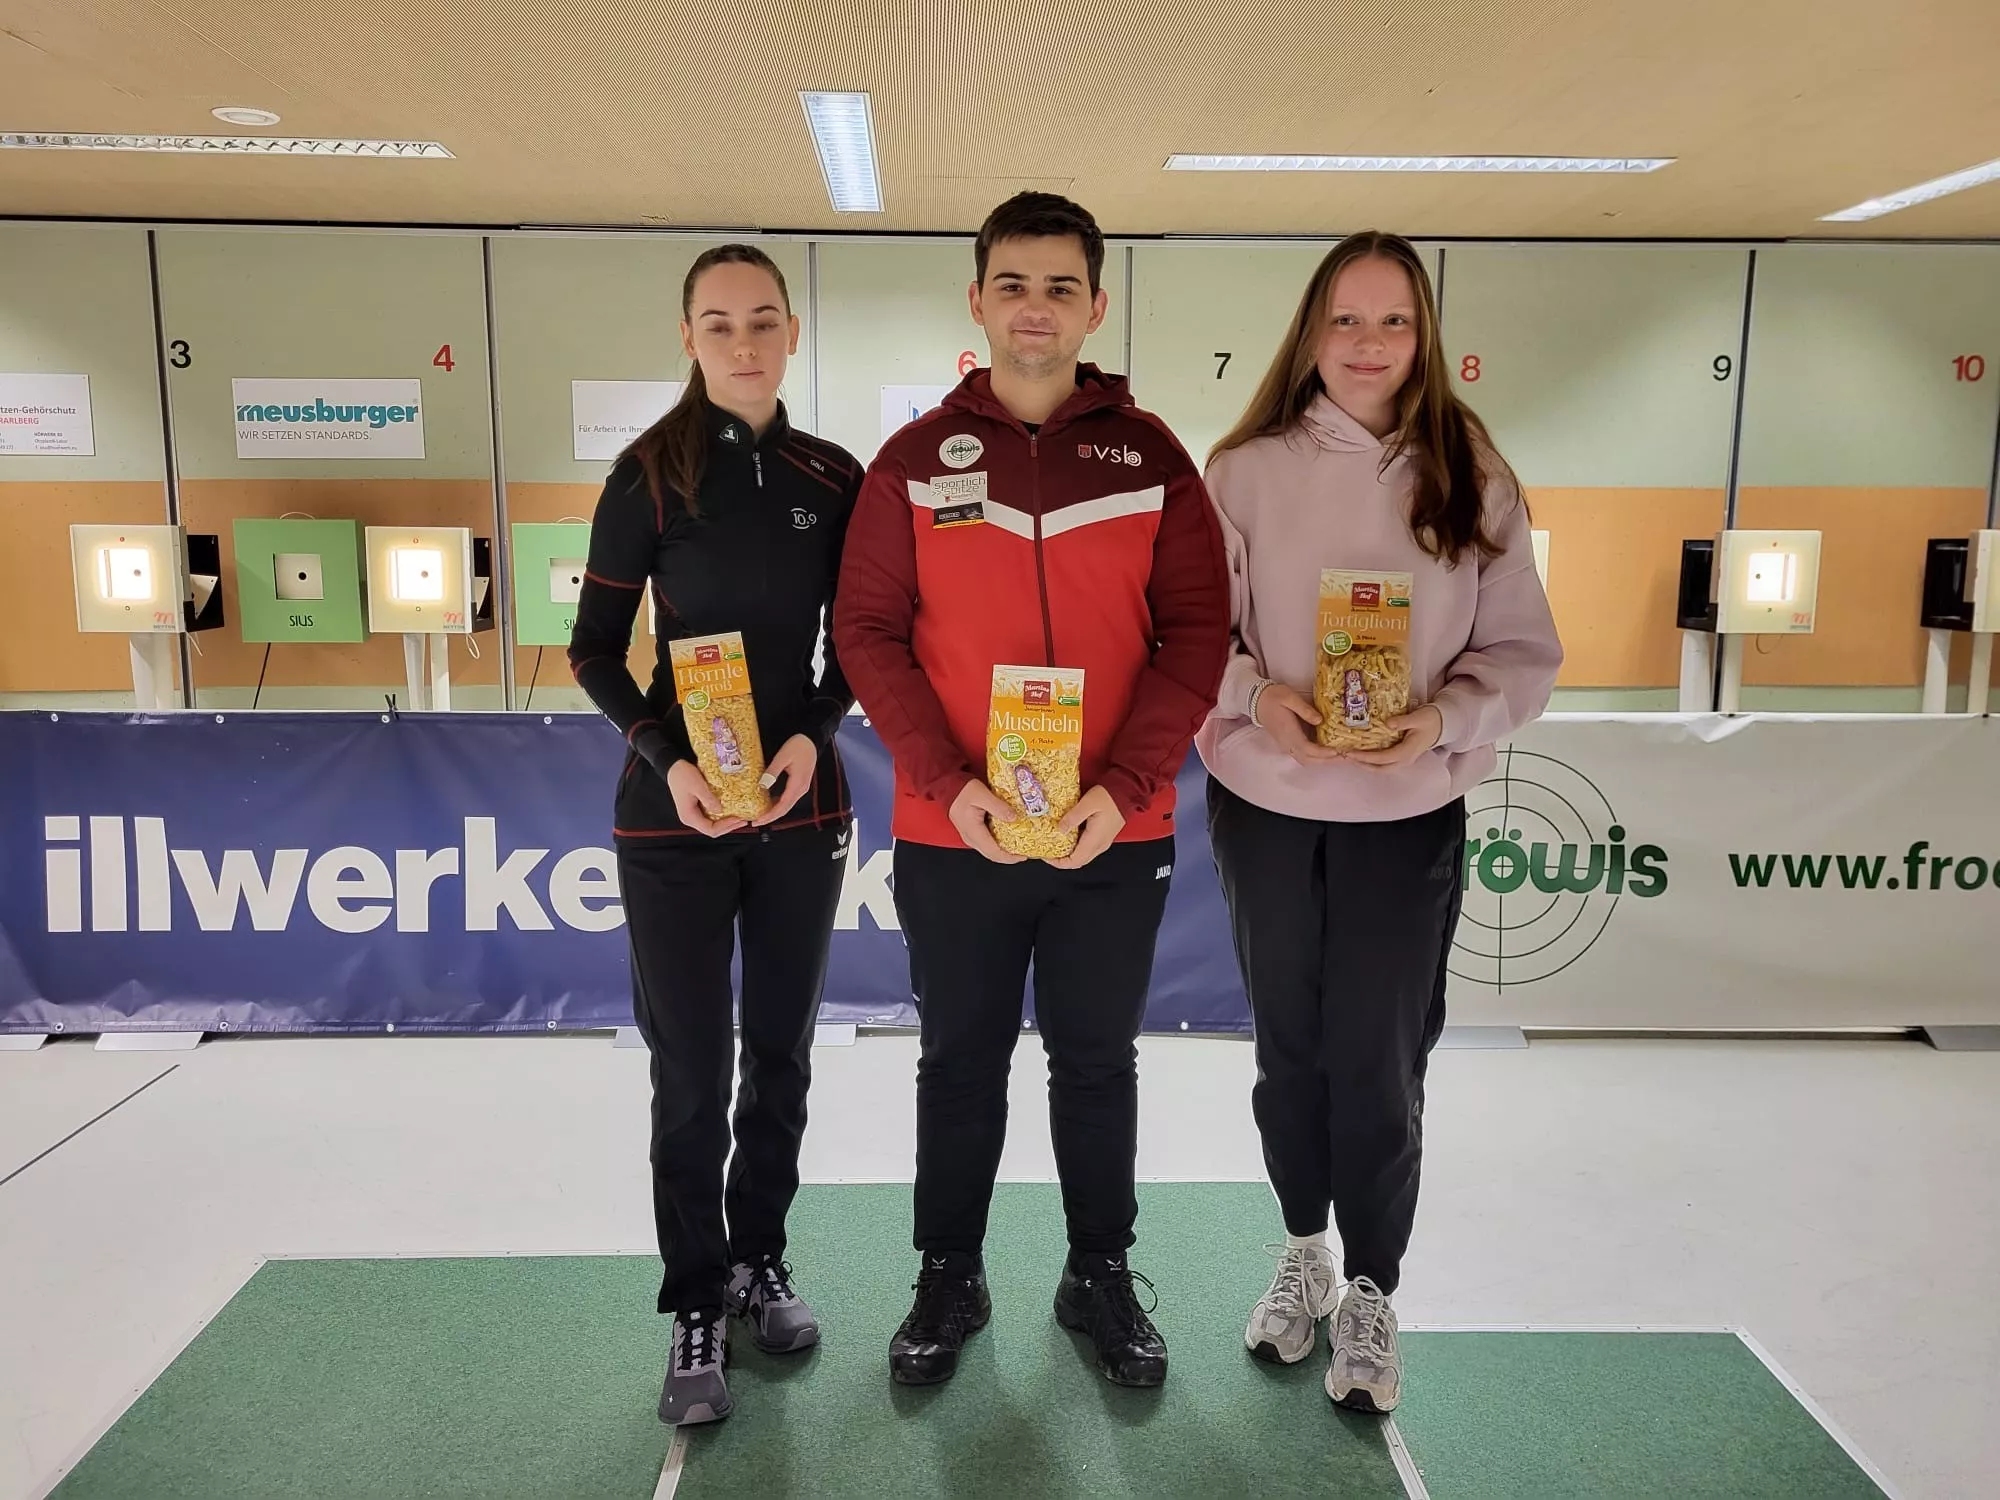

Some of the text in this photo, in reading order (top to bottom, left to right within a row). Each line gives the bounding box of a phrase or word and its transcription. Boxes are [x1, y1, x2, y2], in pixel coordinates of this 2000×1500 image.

[170, 340, 192, 368] 3
[433, 344, 455, 372] 4
[957, 350, 977, 377] 6
[1214, 352, 1232, 379] 7
[1460, 355, 1481, 382] 8
[1712, 355, 1732, 381] 9
[1952, 355, 1985, 382] 10
[237, 398, 419, 428] meusburger
[239, 431, 372, 440] WIR SETZEN STANDARDS.
[934, 476, 986, 491] sportlich
[289, 615, 314, 627] SIUS
[1320, 611, 1408, 632] Tortiglioni
[678, 663, 744, 686] Hörnle
[994, 711, 1080, 734] Muscheln
[45, 816, 627, 932] illwerke
[1155, 864, 1172, 880] JAKO
[1463, 825, 1669, 898] röwis
[1728, 841, 2000, 891] www.fro
